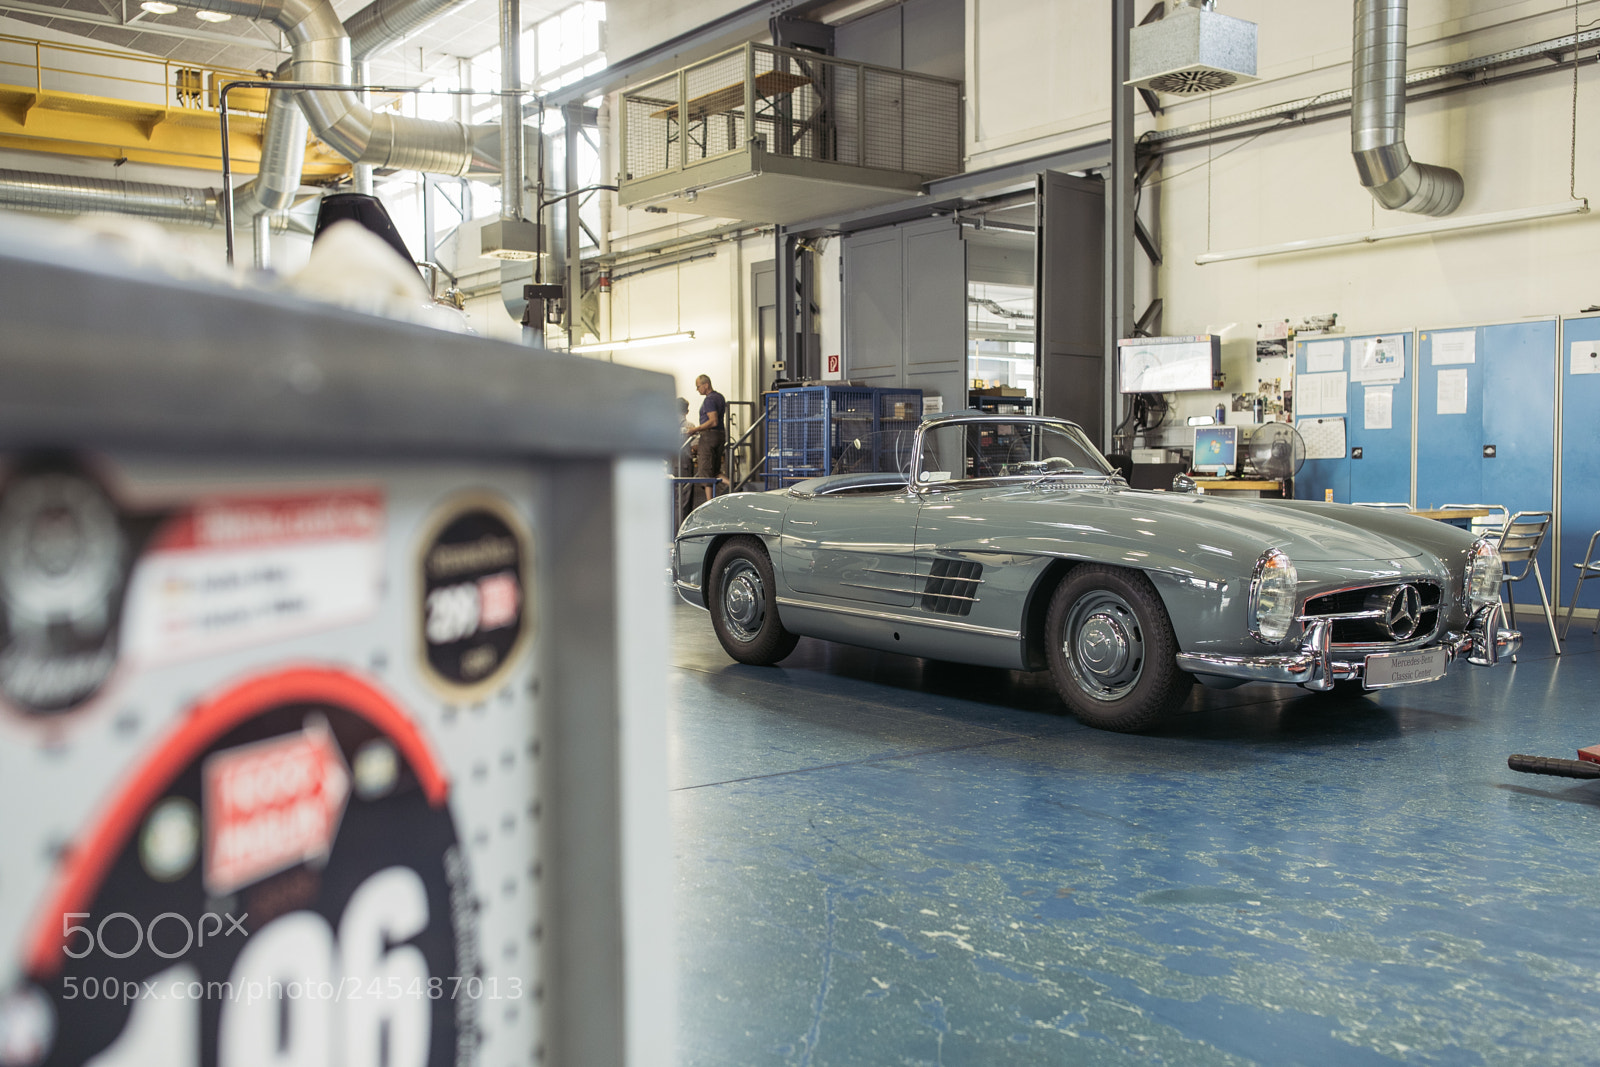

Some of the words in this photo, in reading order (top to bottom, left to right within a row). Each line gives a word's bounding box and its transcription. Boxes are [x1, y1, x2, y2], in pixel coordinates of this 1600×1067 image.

[1391, 655, 1434, 668] Mercedes-Benz
[1391, 671, 1413, 681] Classic
[1414, 669, 1432, 679] Center
